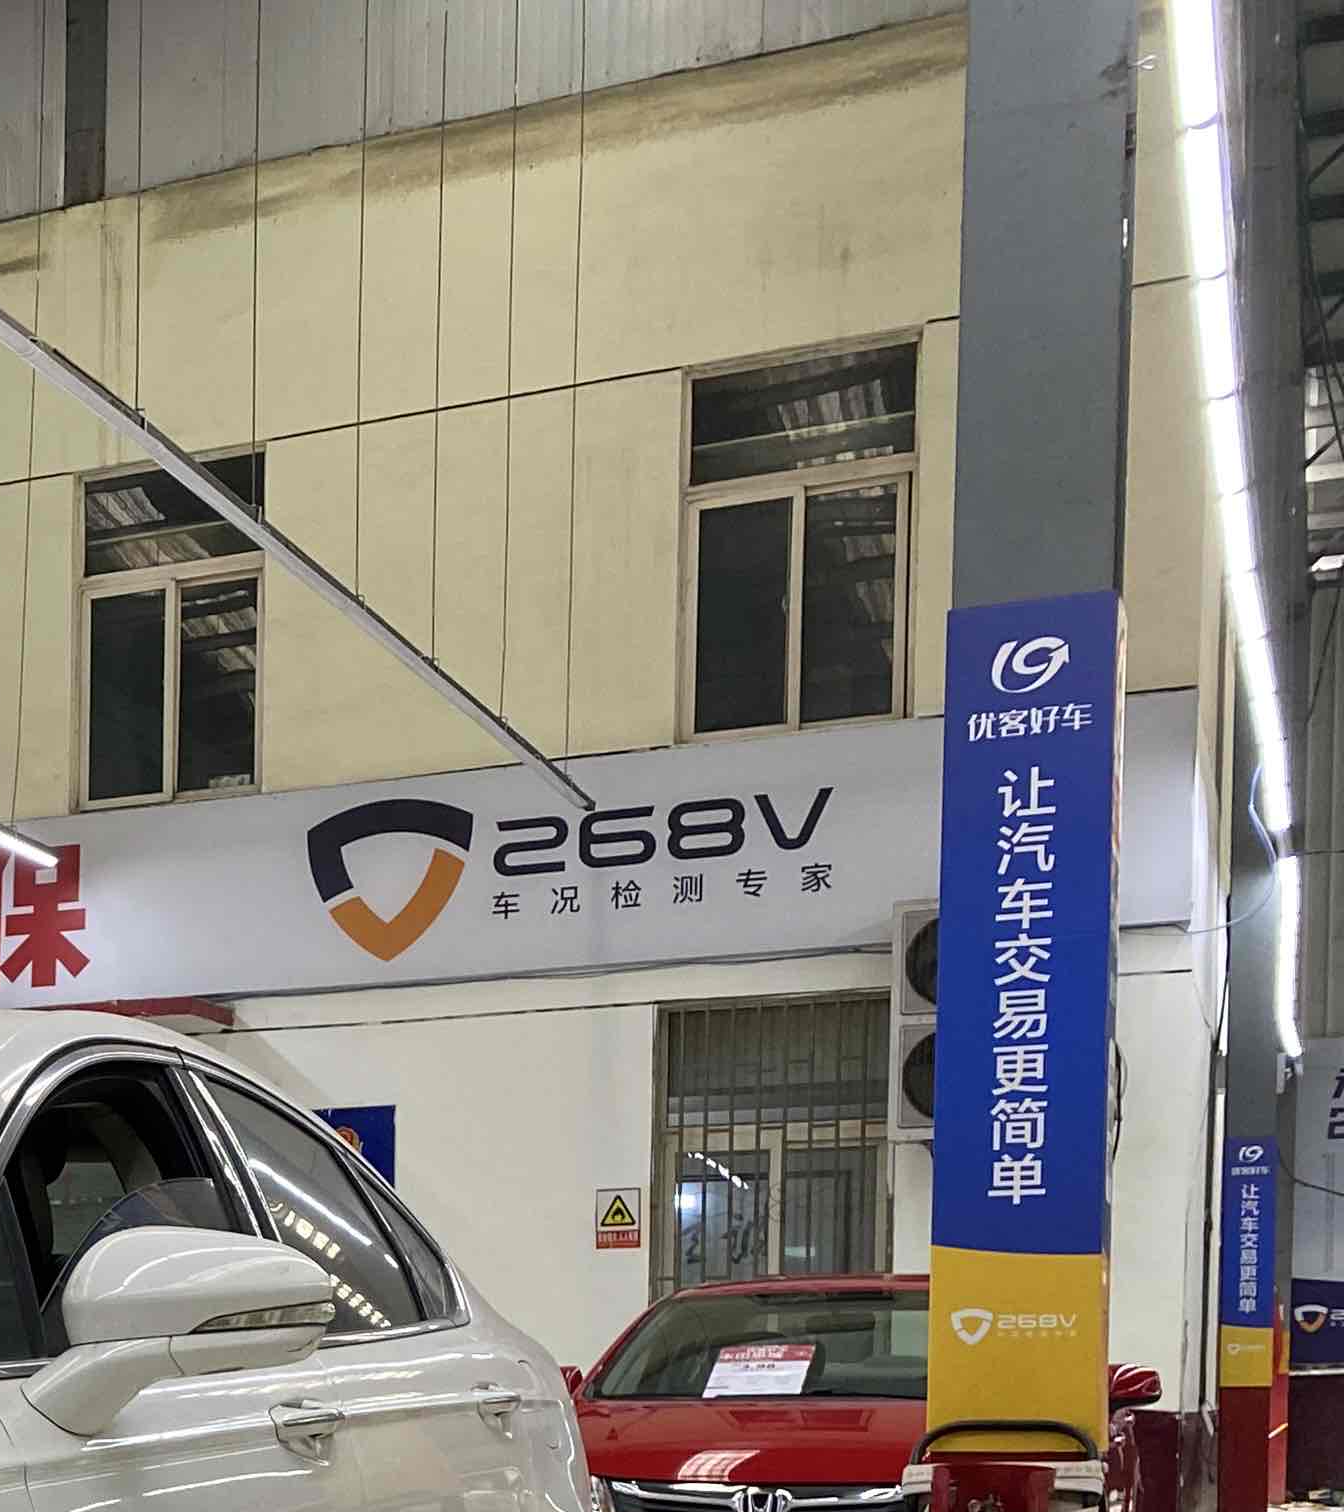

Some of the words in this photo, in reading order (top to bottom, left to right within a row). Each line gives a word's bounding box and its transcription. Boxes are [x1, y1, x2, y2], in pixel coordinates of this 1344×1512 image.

[967, 703, 1093, 742] 优客好车
[492, 786, 834, 877] 268V
[491, 863, 833, 920] 车况检测专家
[987, 766, 1057, 1206] 让汽车交易更简单
[997, 1313, 1077, 1329] 268V
